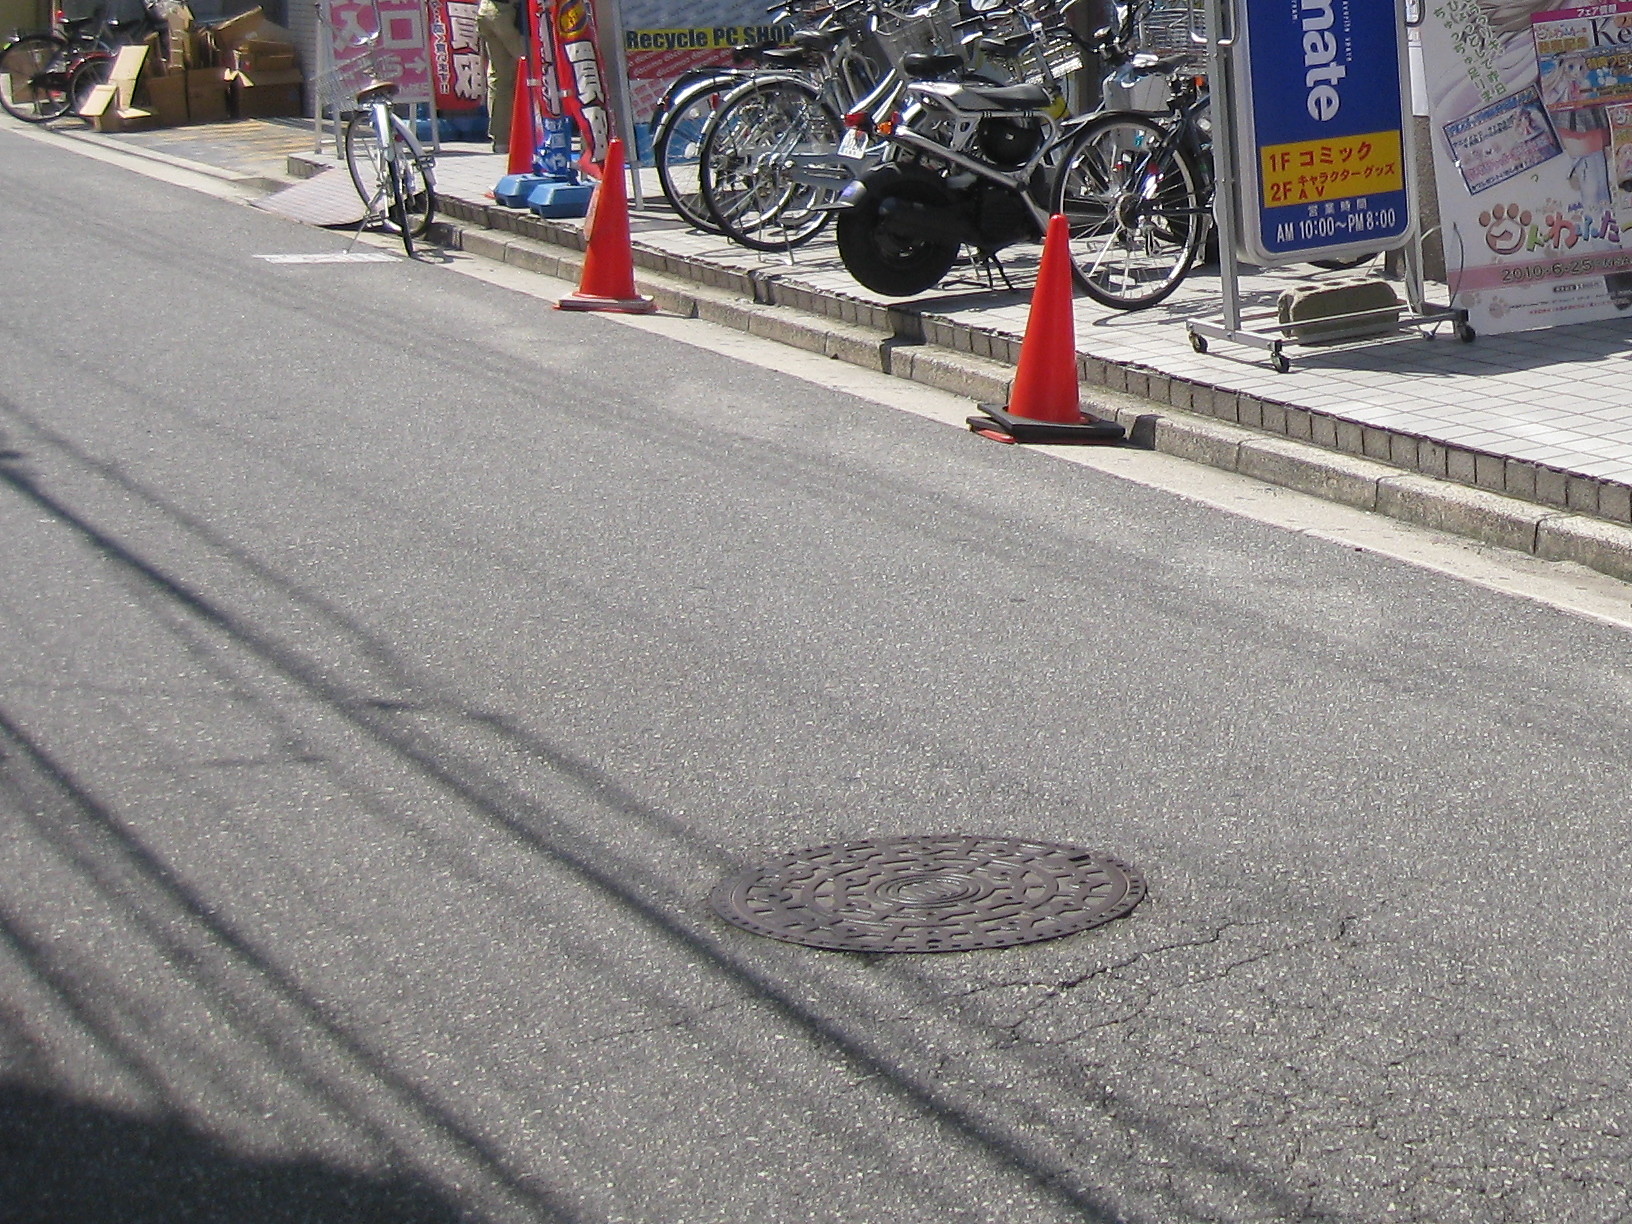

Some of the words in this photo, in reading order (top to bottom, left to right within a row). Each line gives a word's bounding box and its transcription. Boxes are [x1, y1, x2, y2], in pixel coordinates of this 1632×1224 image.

[626, 29, 708, 50] Recycle
[713, 27, 738, 46] PC
[1269, 152, 1290, 172] 1F
[1299, 141, 1372, 167] コミック
[1270, 181, 1293, 202] 2F
[1298, 162, 1395, 187] キャラクターグッズ
[1307, 197, 1367, 217] 営業時間
[1277, 222, 1294, 243] AM
[1366, 208, 1396, 231] 8:00
